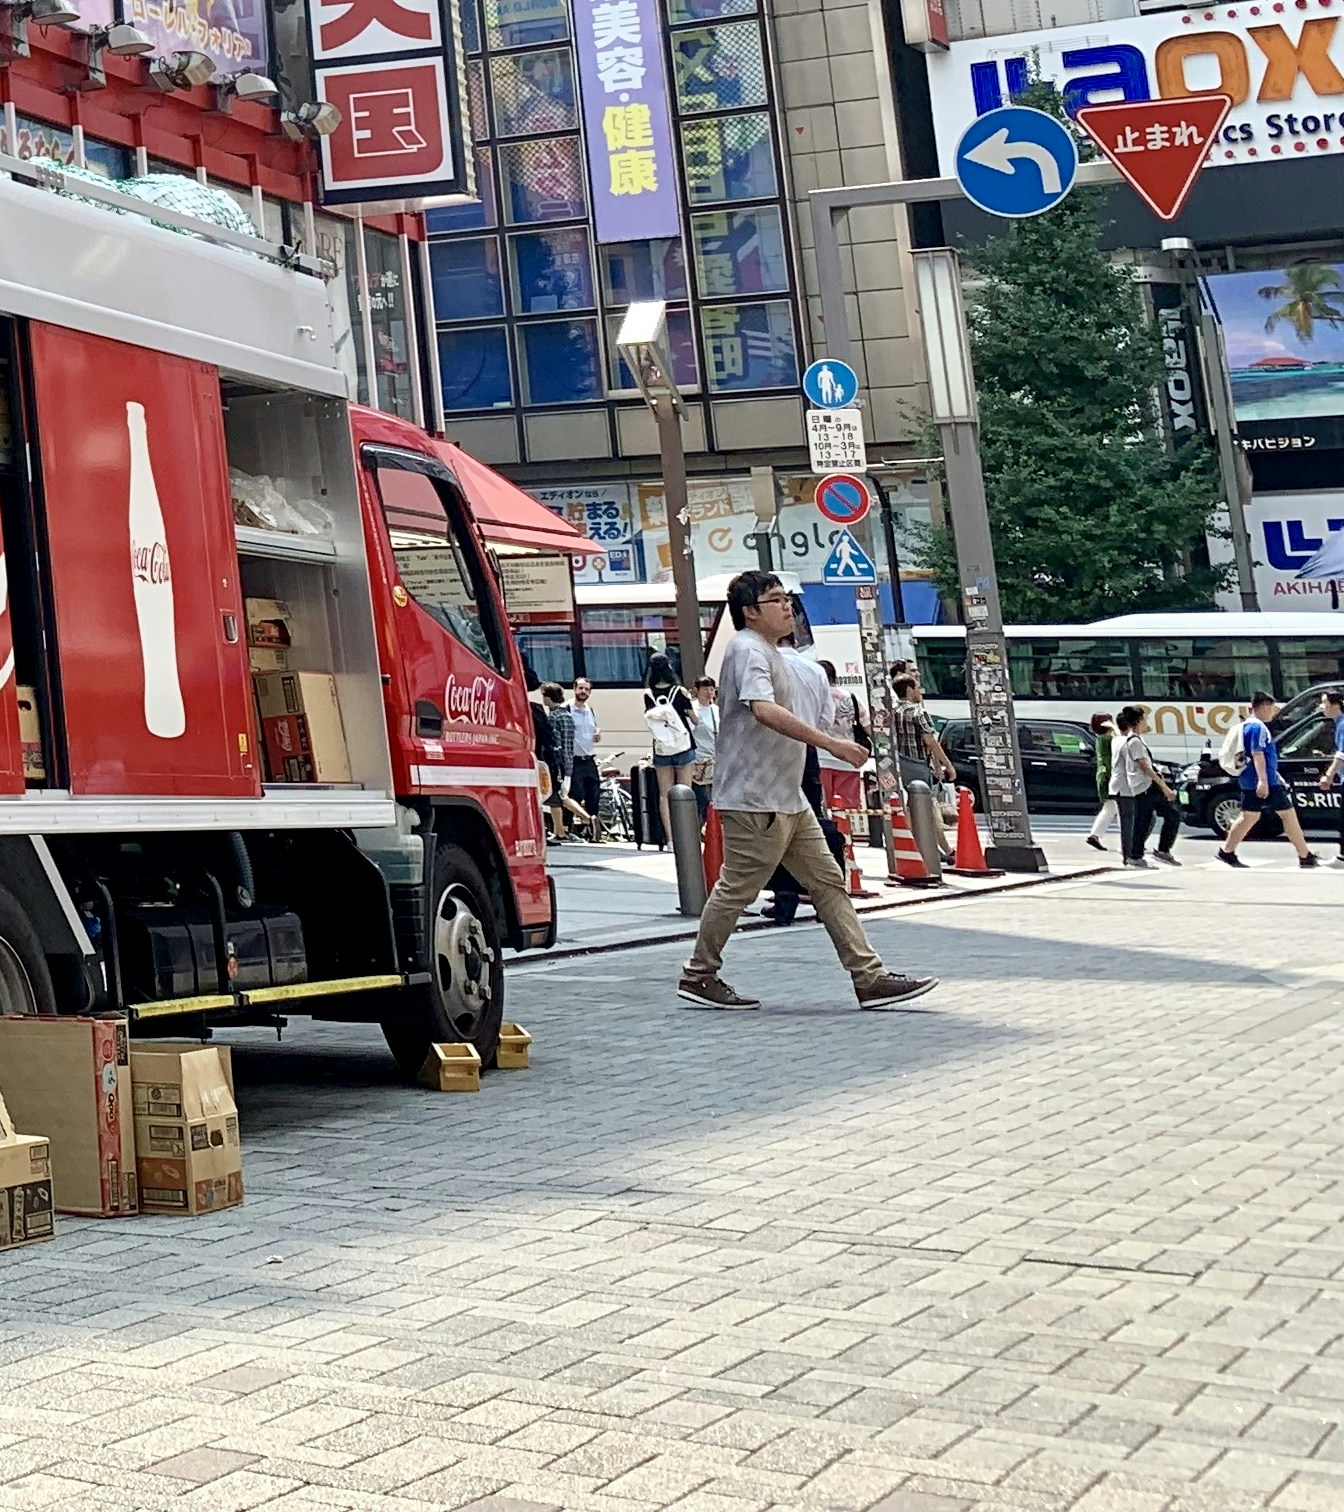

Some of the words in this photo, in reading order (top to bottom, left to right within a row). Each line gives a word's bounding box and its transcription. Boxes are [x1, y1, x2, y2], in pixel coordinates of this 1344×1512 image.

[1113, 120, 1205, 155] 止まれ
[1233, 434, 1316, 452] キバビジョン
